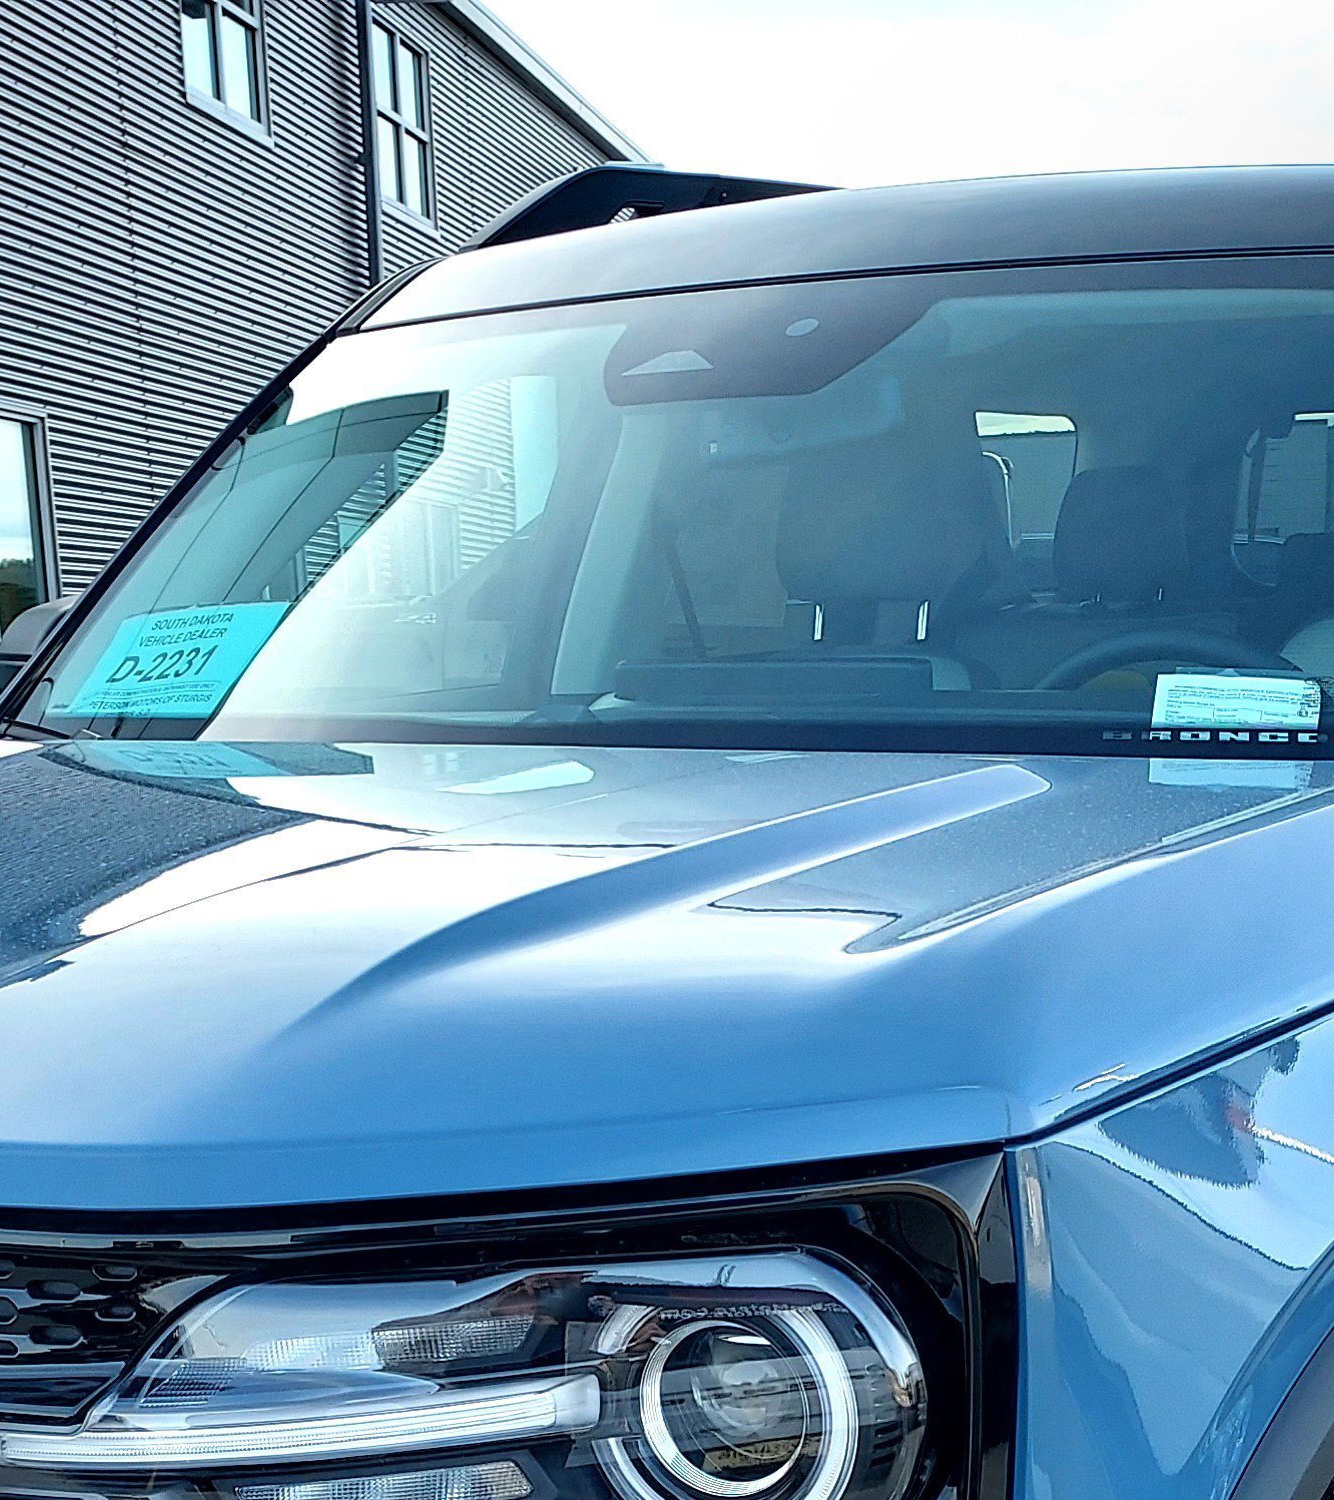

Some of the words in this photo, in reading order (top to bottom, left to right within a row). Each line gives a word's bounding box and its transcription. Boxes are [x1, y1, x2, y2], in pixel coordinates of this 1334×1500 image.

[151, 618, 190, 631] SOUTH
[188, 612, 235, 627] DAKOTA
[139, 633, 186, 648] VEHICLE
[183, 628, 228, 641] DEALER
[105, 645, 220, 684] D-2231
[173, 693, 213, 704] STURGIS
